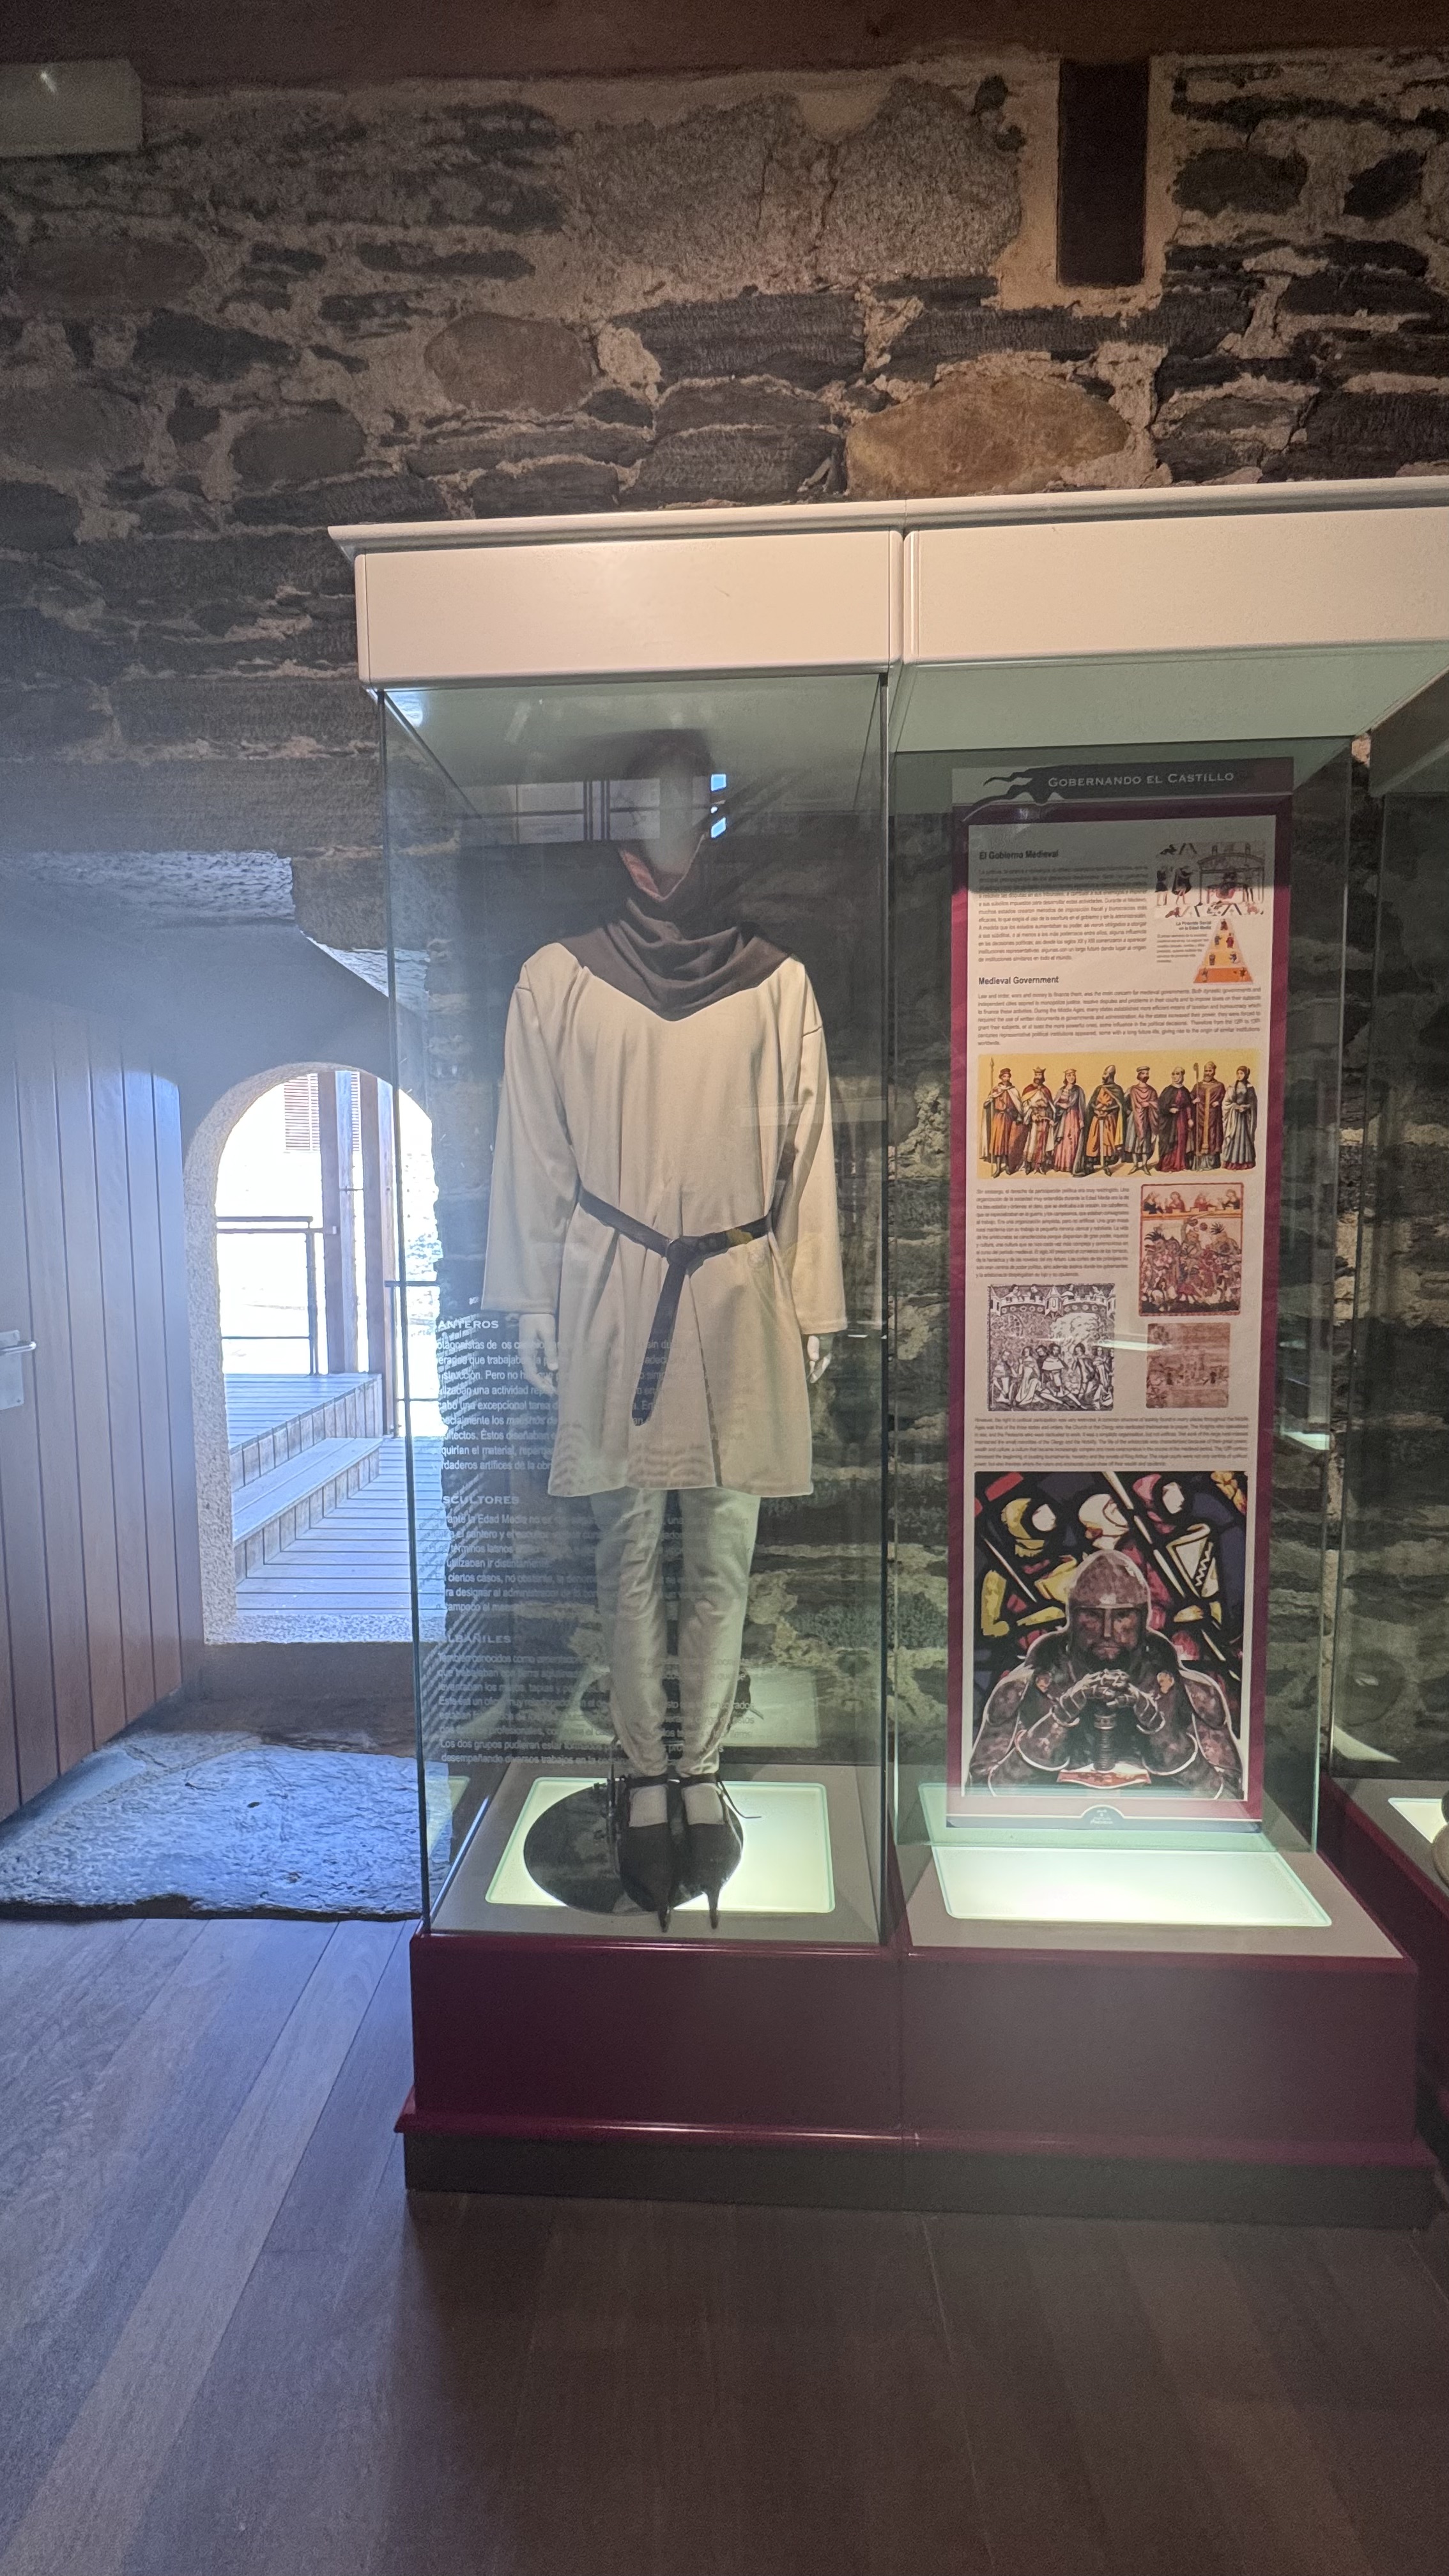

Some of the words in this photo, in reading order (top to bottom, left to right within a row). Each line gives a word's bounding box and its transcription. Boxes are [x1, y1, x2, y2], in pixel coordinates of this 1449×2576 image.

[1048, 776, 1142, 788] GOBERNANDO
[1147, 775, 1162, 785] EL
[1168, 772, 1234, 783] CASTILLO
[979, 851, 987, 859] El
[989, 851, 1023, 859] Gobierno
[1025, 850, 1059, 858] Medieval
[978, 976, 1011, 985] Medieval
[1013, 976, 1059, 985] Government
[433, 1320, 499, 1329] ANTEROS
[486, 1339, 496, 1349] de
[469, 1356, 485, 1366] que
[487, 1354, 521, 1367] trabajab
[486, 1370, 505, 1379] Pero
[492, 1385, 528, 1395] actividad
[477, 1400, 526, 1411] excepcional
[492, 1415, 504, 1424] los
[480, 1428, 504, 1439] Éstos
[471, 1445, 479, 1455] el
[480, 1459, 512, 1470] artífices
[514, 1460, 525, 1469] de
[527, 1460, 535, 1469] la
[537, 1460, 551, 1469] obr
[442, 1496, 519, 1505] SCULTORES
[478, 1514, 499, 1524] Edad
[502, 1515, 526, 1524] Media
[499, 1531, 503, 1540] y
[448, 1574, 475, 1583] ciertos
[477, 1574, 503, 1584] casos,
[448, 1633, 512, 1643] LBAÑILES
[440, 1740, 455, 1749] Los
[457, 1740, 472, 1749] dos
[474, 1741, 502, 1751] grupos
